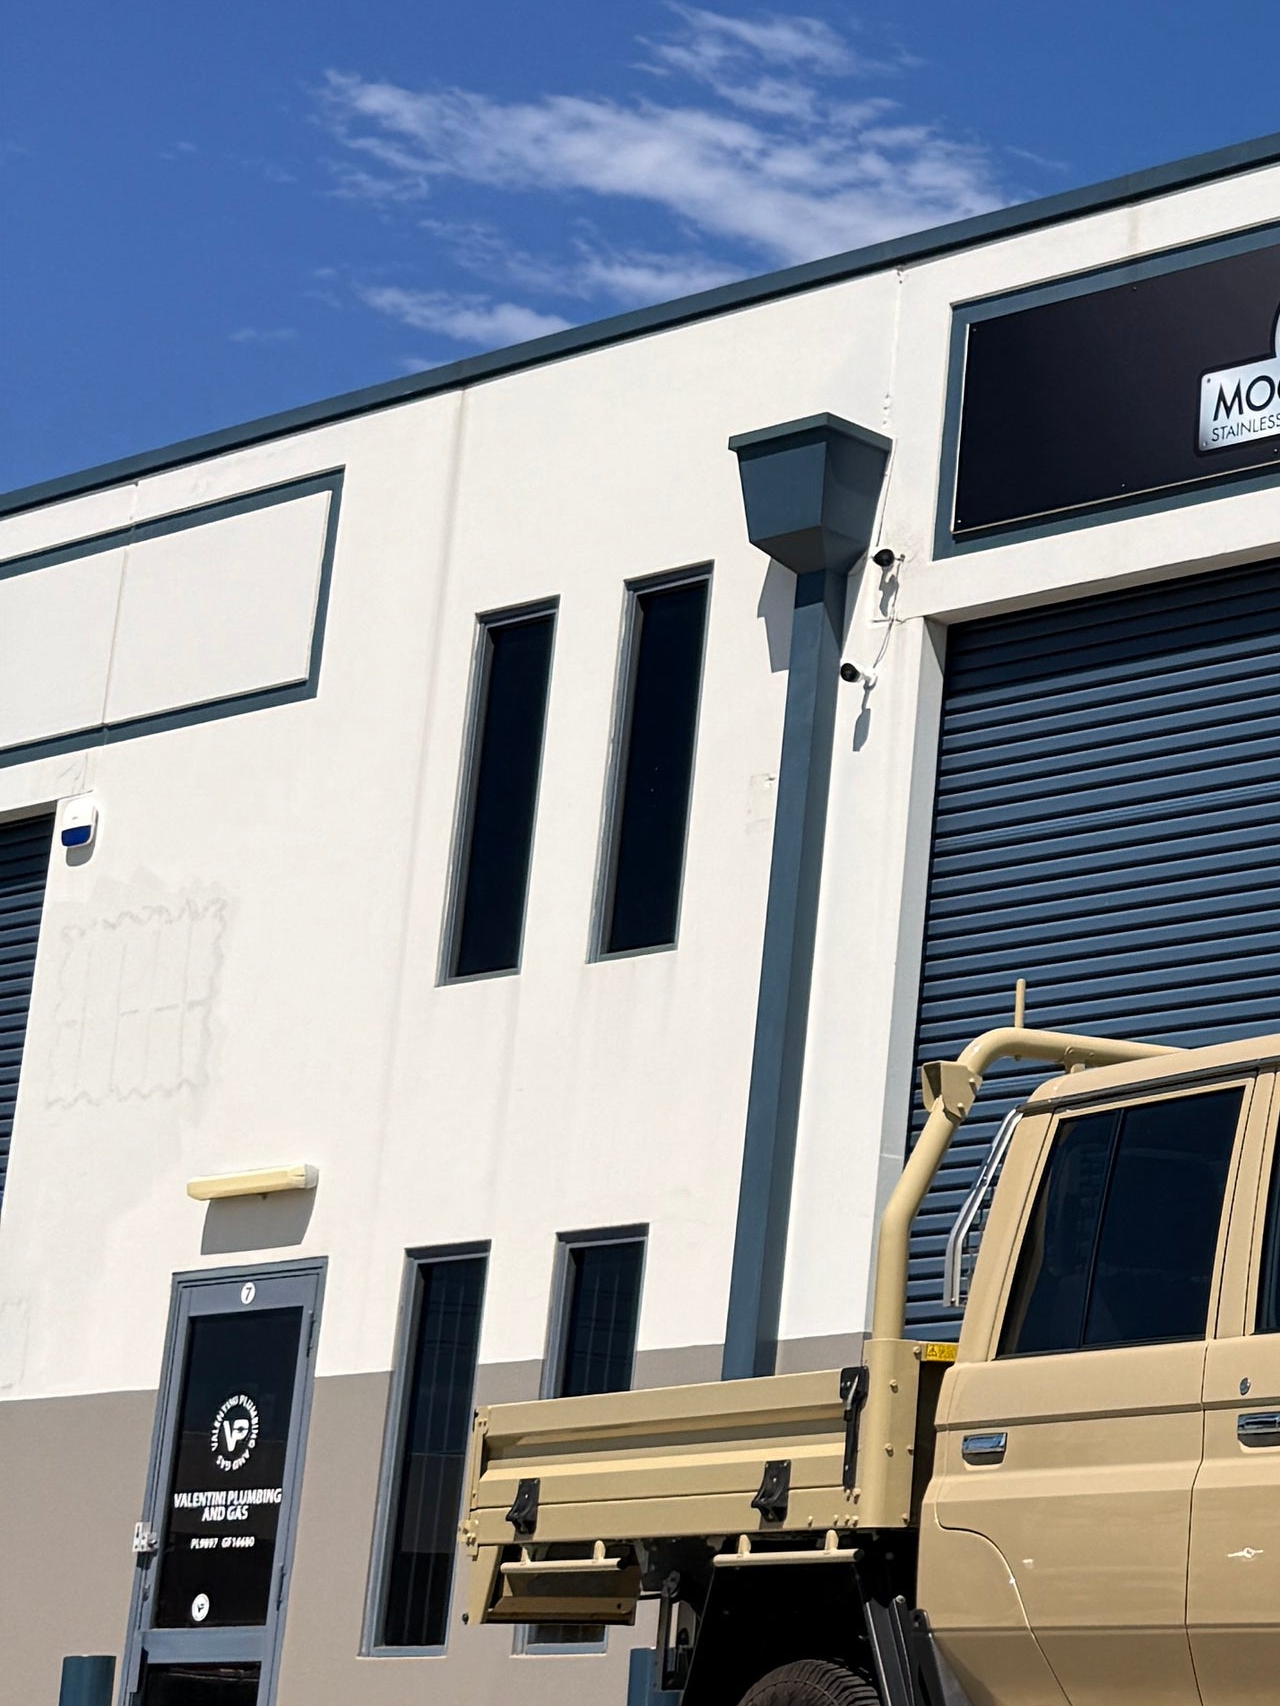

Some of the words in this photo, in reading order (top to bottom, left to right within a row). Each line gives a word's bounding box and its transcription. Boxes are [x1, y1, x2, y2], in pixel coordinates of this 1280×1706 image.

[245, 1286, 253, 1301] 7
[174, 1491, 227, 1508] VALENTINI
[227, 1488, 282, 1506] PLUMBING
[201, 1506, 225, 1522] AND
[226, 1505, 249, 1521] GAS
